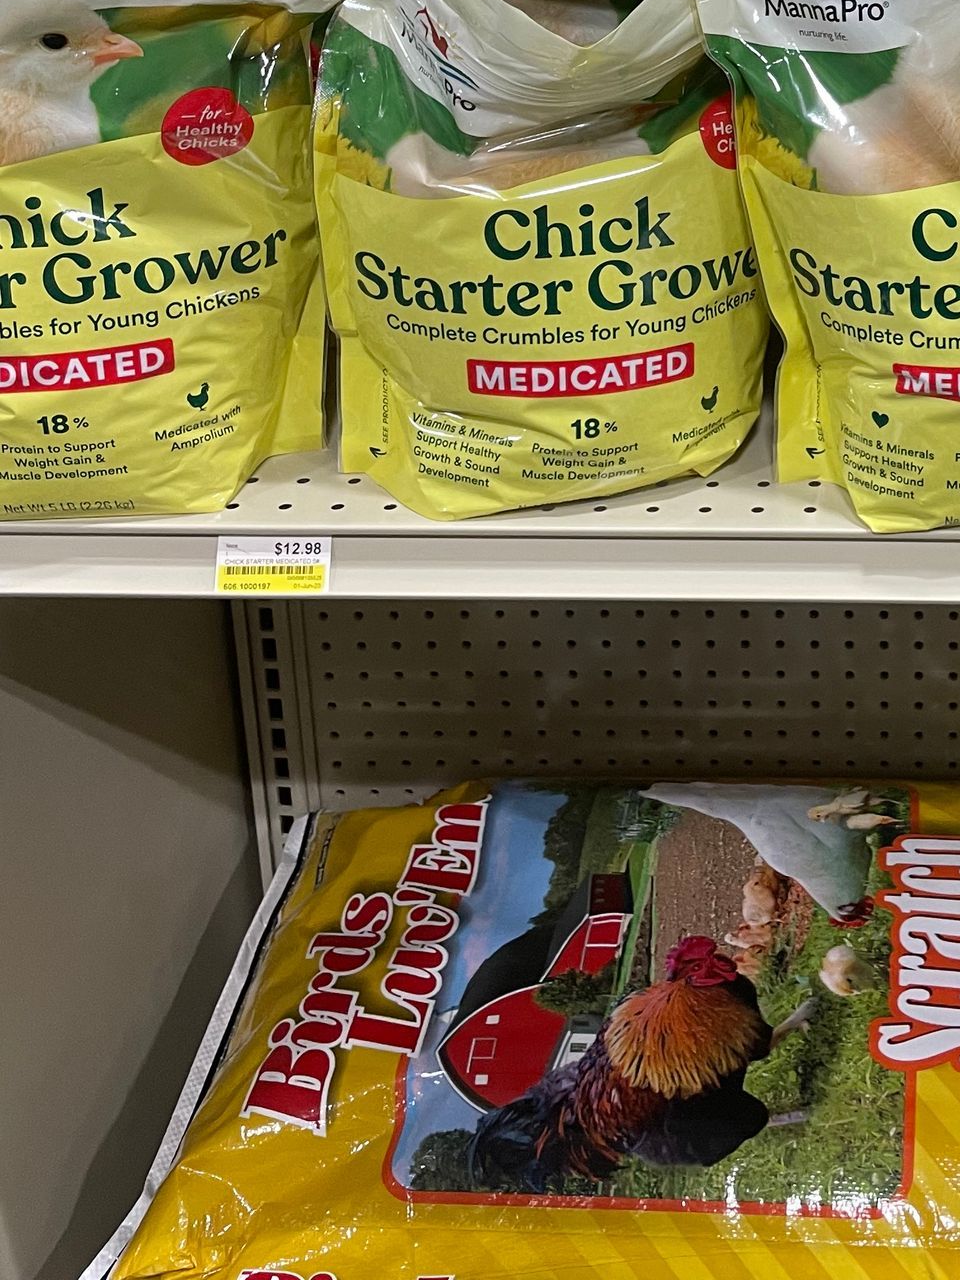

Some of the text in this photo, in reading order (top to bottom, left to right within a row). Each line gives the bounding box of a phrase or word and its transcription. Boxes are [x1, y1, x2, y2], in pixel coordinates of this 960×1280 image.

[176, 121, 243, 140] Healthy
[177, 133, 238, 151] Chicks
[484, 196, 675, 261] Chick
[42, 228, 287, 305] Grower
[354, 251, 573, 317] Starter
[50, 285, 261, 337] for Young Chickens
[386, 287, 757, 346] Complete Crumbles for Young Chickens
[820, 311, 904, 347] Complete
[474, 351, 689, 393] MEDICATED
[154, 404, 242, 441] Medicated with
[170, 424, 235, 452] Amprolium
[413, 445, 453, 466] Growth
[416, 431, 502, 463] Support Healthy
[417, 462, 490, 489] Development
[274, 542, 322, 556] $12.98
[240, 893, 395, 1137] Birds
